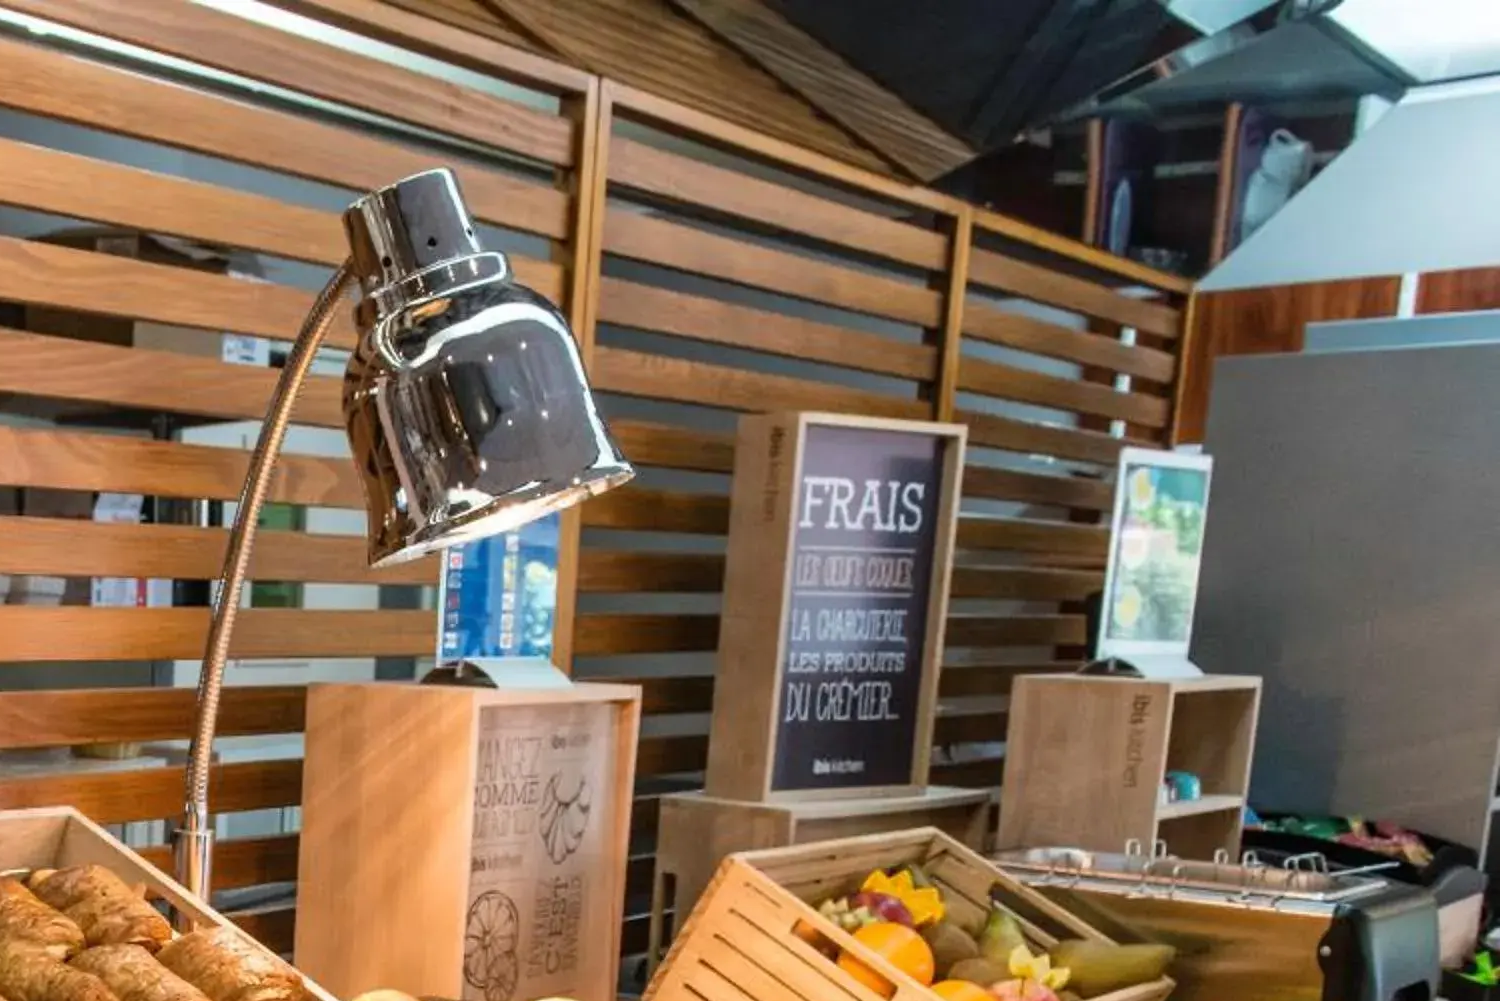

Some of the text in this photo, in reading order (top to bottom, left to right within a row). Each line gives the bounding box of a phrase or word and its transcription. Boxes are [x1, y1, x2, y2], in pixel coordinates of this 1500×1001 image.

[799, 476, 925, 532] FRAIS
[796, 554, 820, 587] LES
[791, 608, 812, 641] LA
[788, 652, 907, 673] LES PRODUITS
[785, 682, 812, 723] DU
